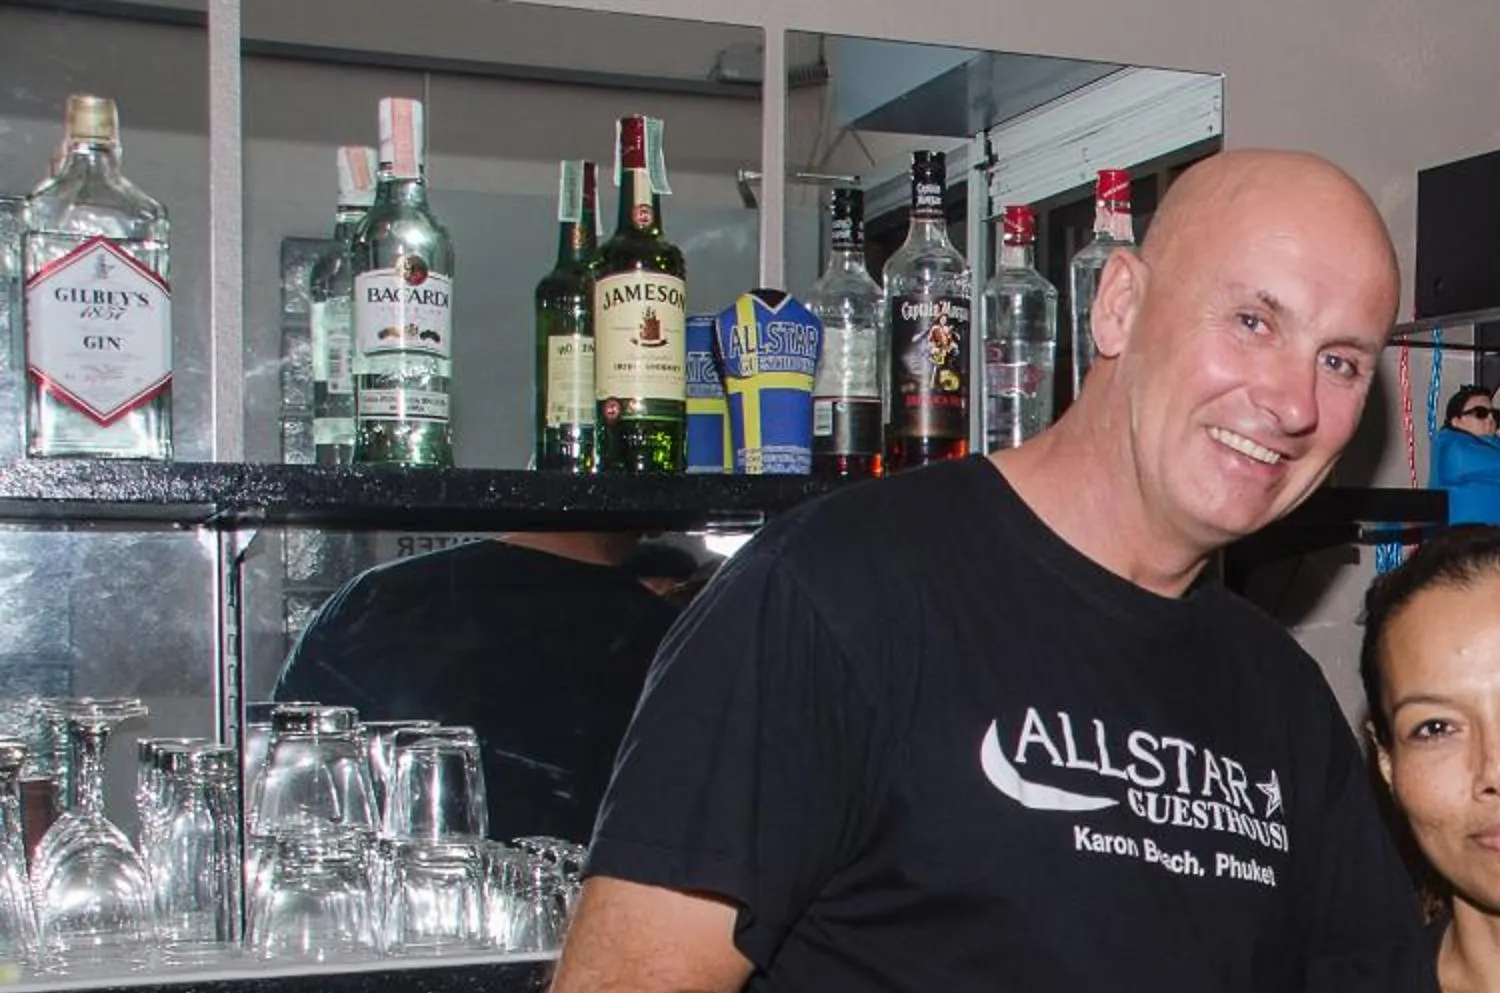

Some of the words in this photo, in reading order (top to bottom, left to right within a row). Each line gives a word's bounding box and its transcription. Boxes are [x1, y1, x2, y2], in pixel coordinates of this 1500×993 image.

[55, 286, 150, 308] GILBEY'S
[603, 283, 687, 315] JAMESON
[83, 335, 123, 351] GIN
[729, 321, 819, 360] ALLSTAR
[1014, 706, 1255, 814] ALLSTAR
[1073, 825, 1140, 858] Karon
